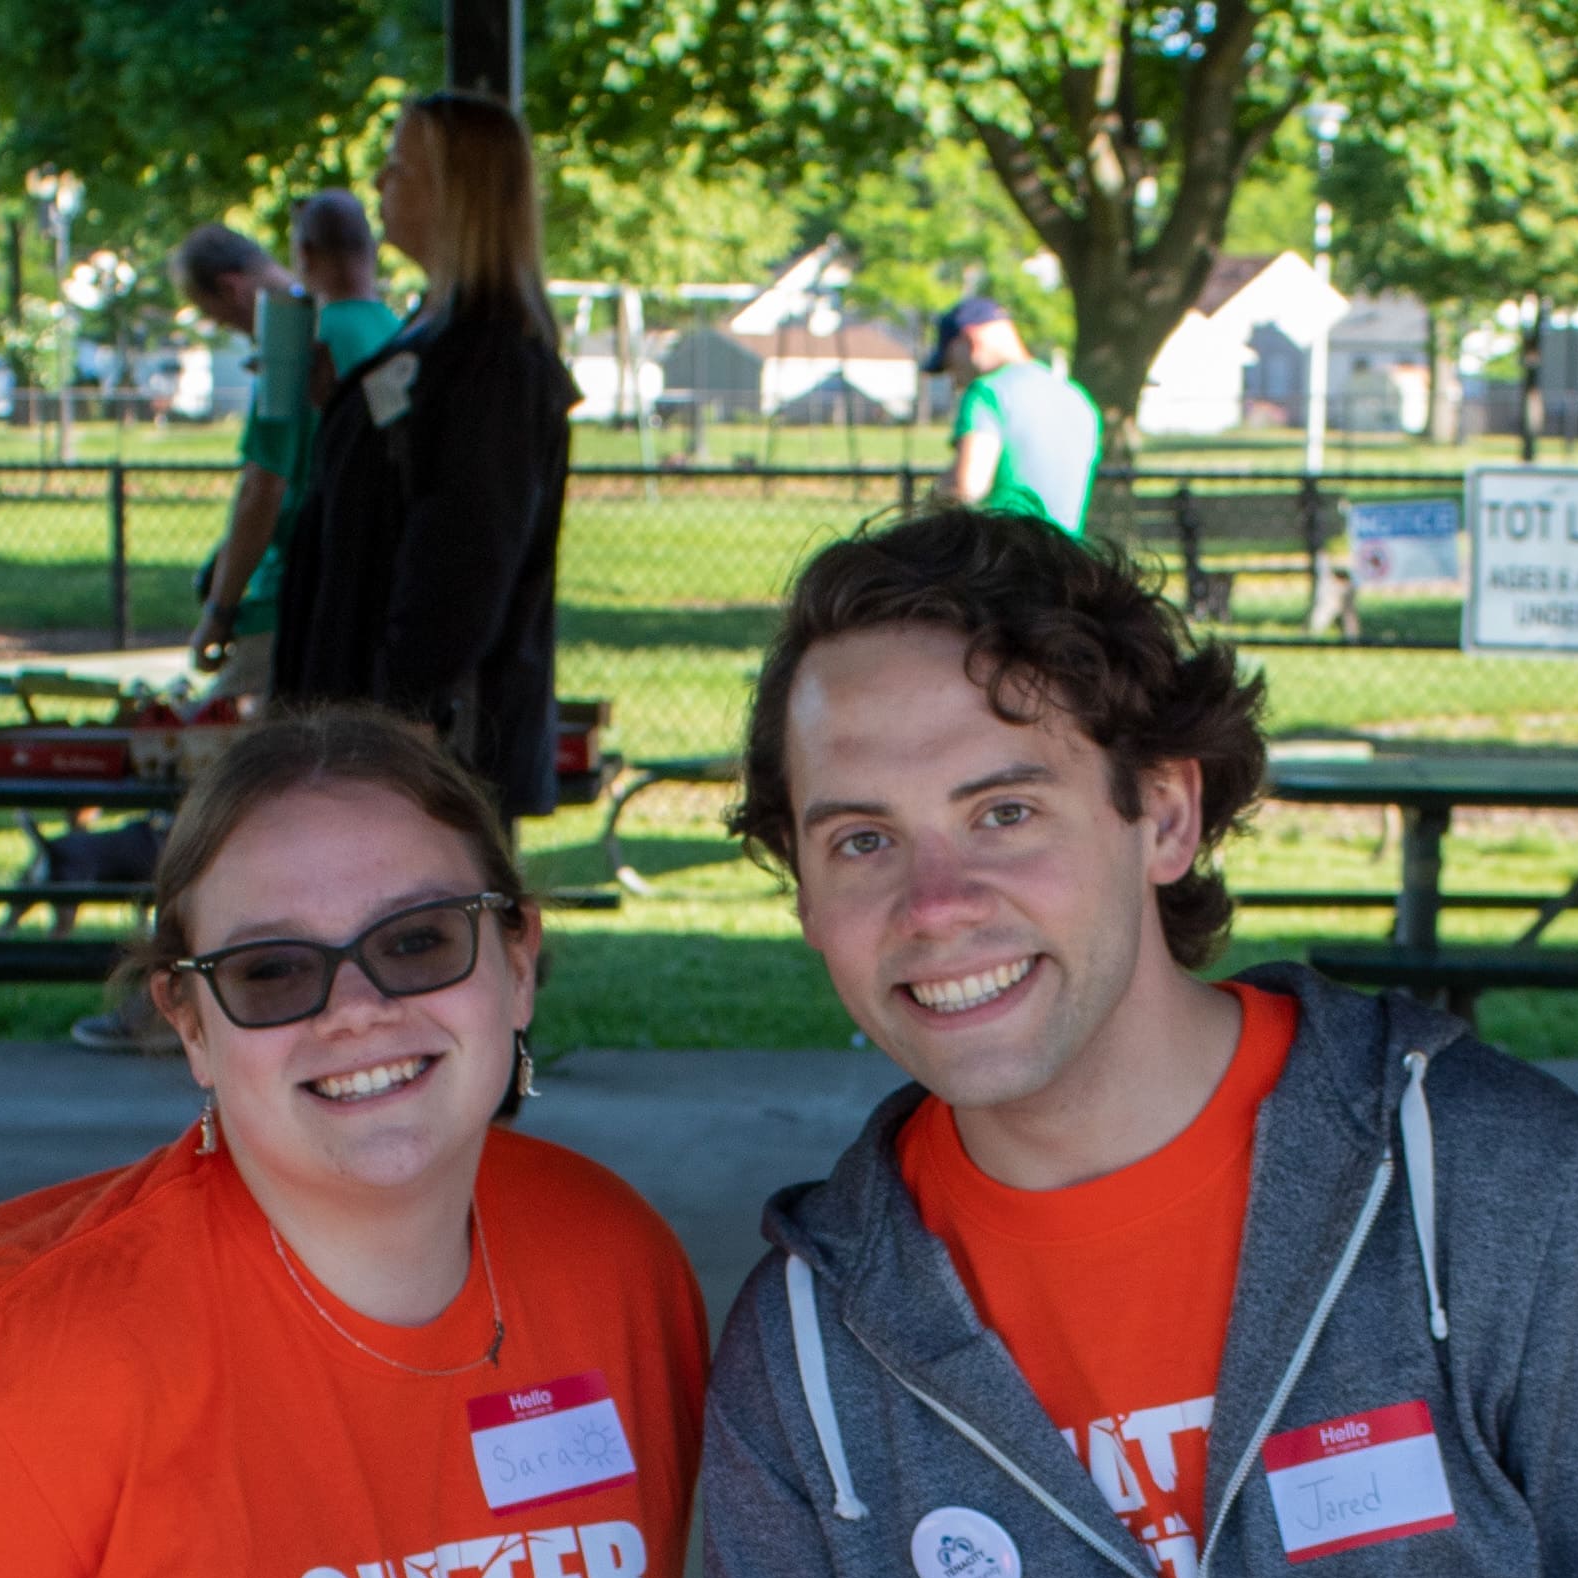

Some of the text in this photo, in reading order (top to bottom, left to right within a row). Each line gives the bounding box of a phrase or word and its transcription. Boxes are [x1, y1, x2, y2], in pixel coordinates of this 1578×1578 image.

[1487, 501, 1552, 541] TOT
[509, 1389, 553, 1411] Hello
[1319, 1421, 1370, 1446] Hello
[492, 1444, 575, 1483] Sara
[1295, 1472, 1382, 1531] Jared
